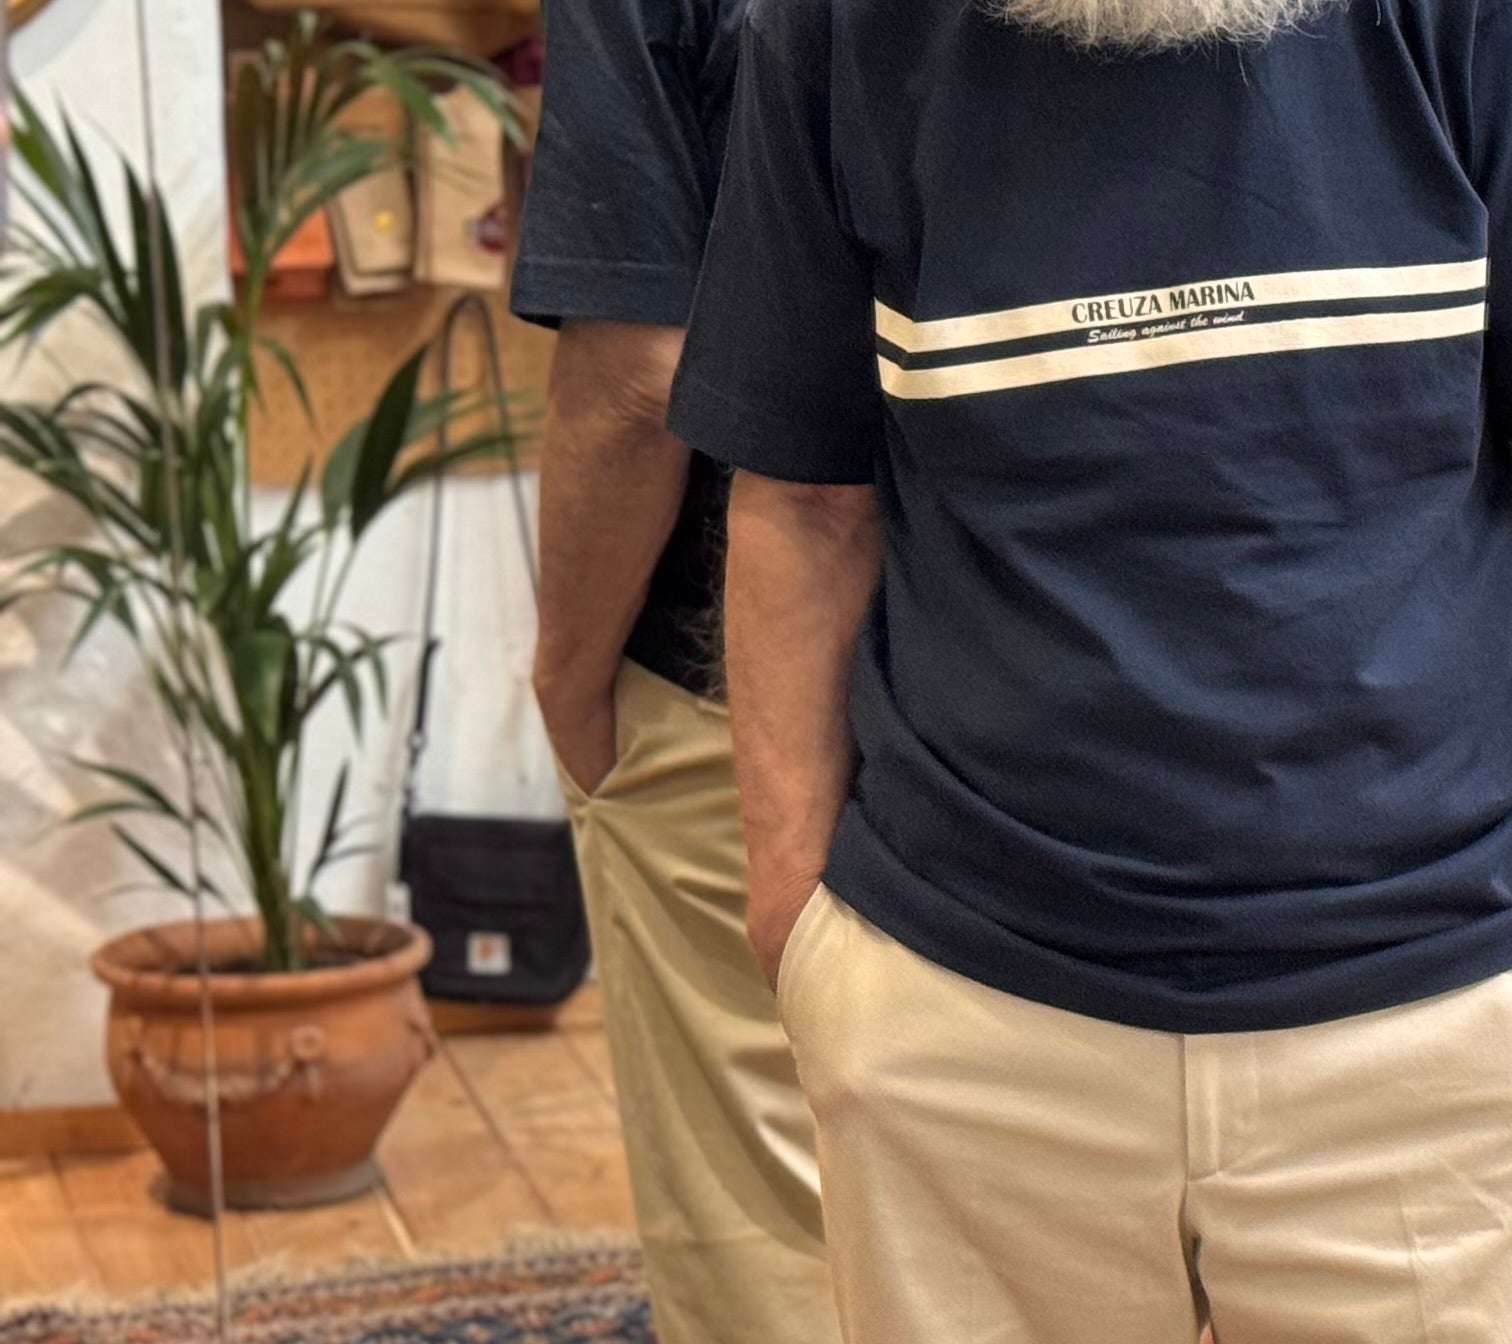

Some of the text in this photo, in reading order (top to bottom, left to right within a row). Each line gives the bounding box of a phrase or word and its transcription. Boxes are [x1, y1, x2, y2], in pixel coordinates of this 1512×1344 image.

[1071, 280, 1256, 324] CREUZA MARINA
[1086, 309, 1245, 344] Sailing against the wind
